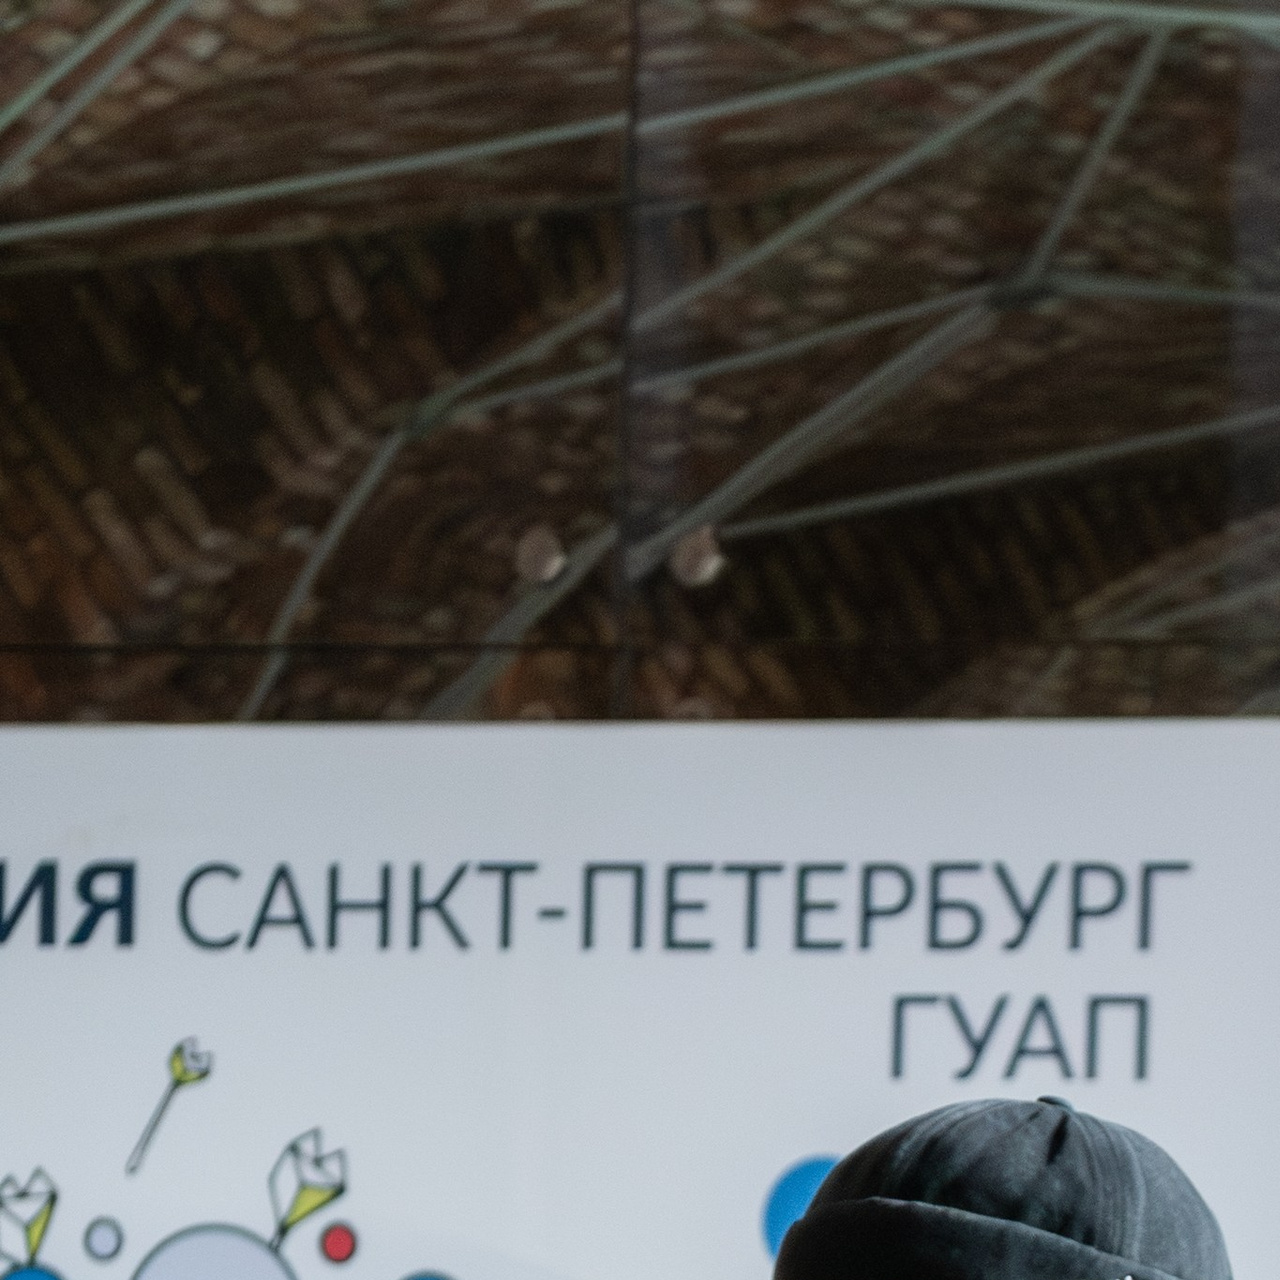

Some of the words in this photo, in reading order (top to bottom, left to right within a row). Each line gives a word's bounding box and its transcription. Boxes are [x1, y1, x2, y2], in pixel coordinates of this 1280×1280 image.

[0, 859, 137, 947] ИЯ
[177, 861, 1193, 950] САНКТ-ПЕТЕРБУРГ
[889, 993, 1151, 1081] ГУАП
